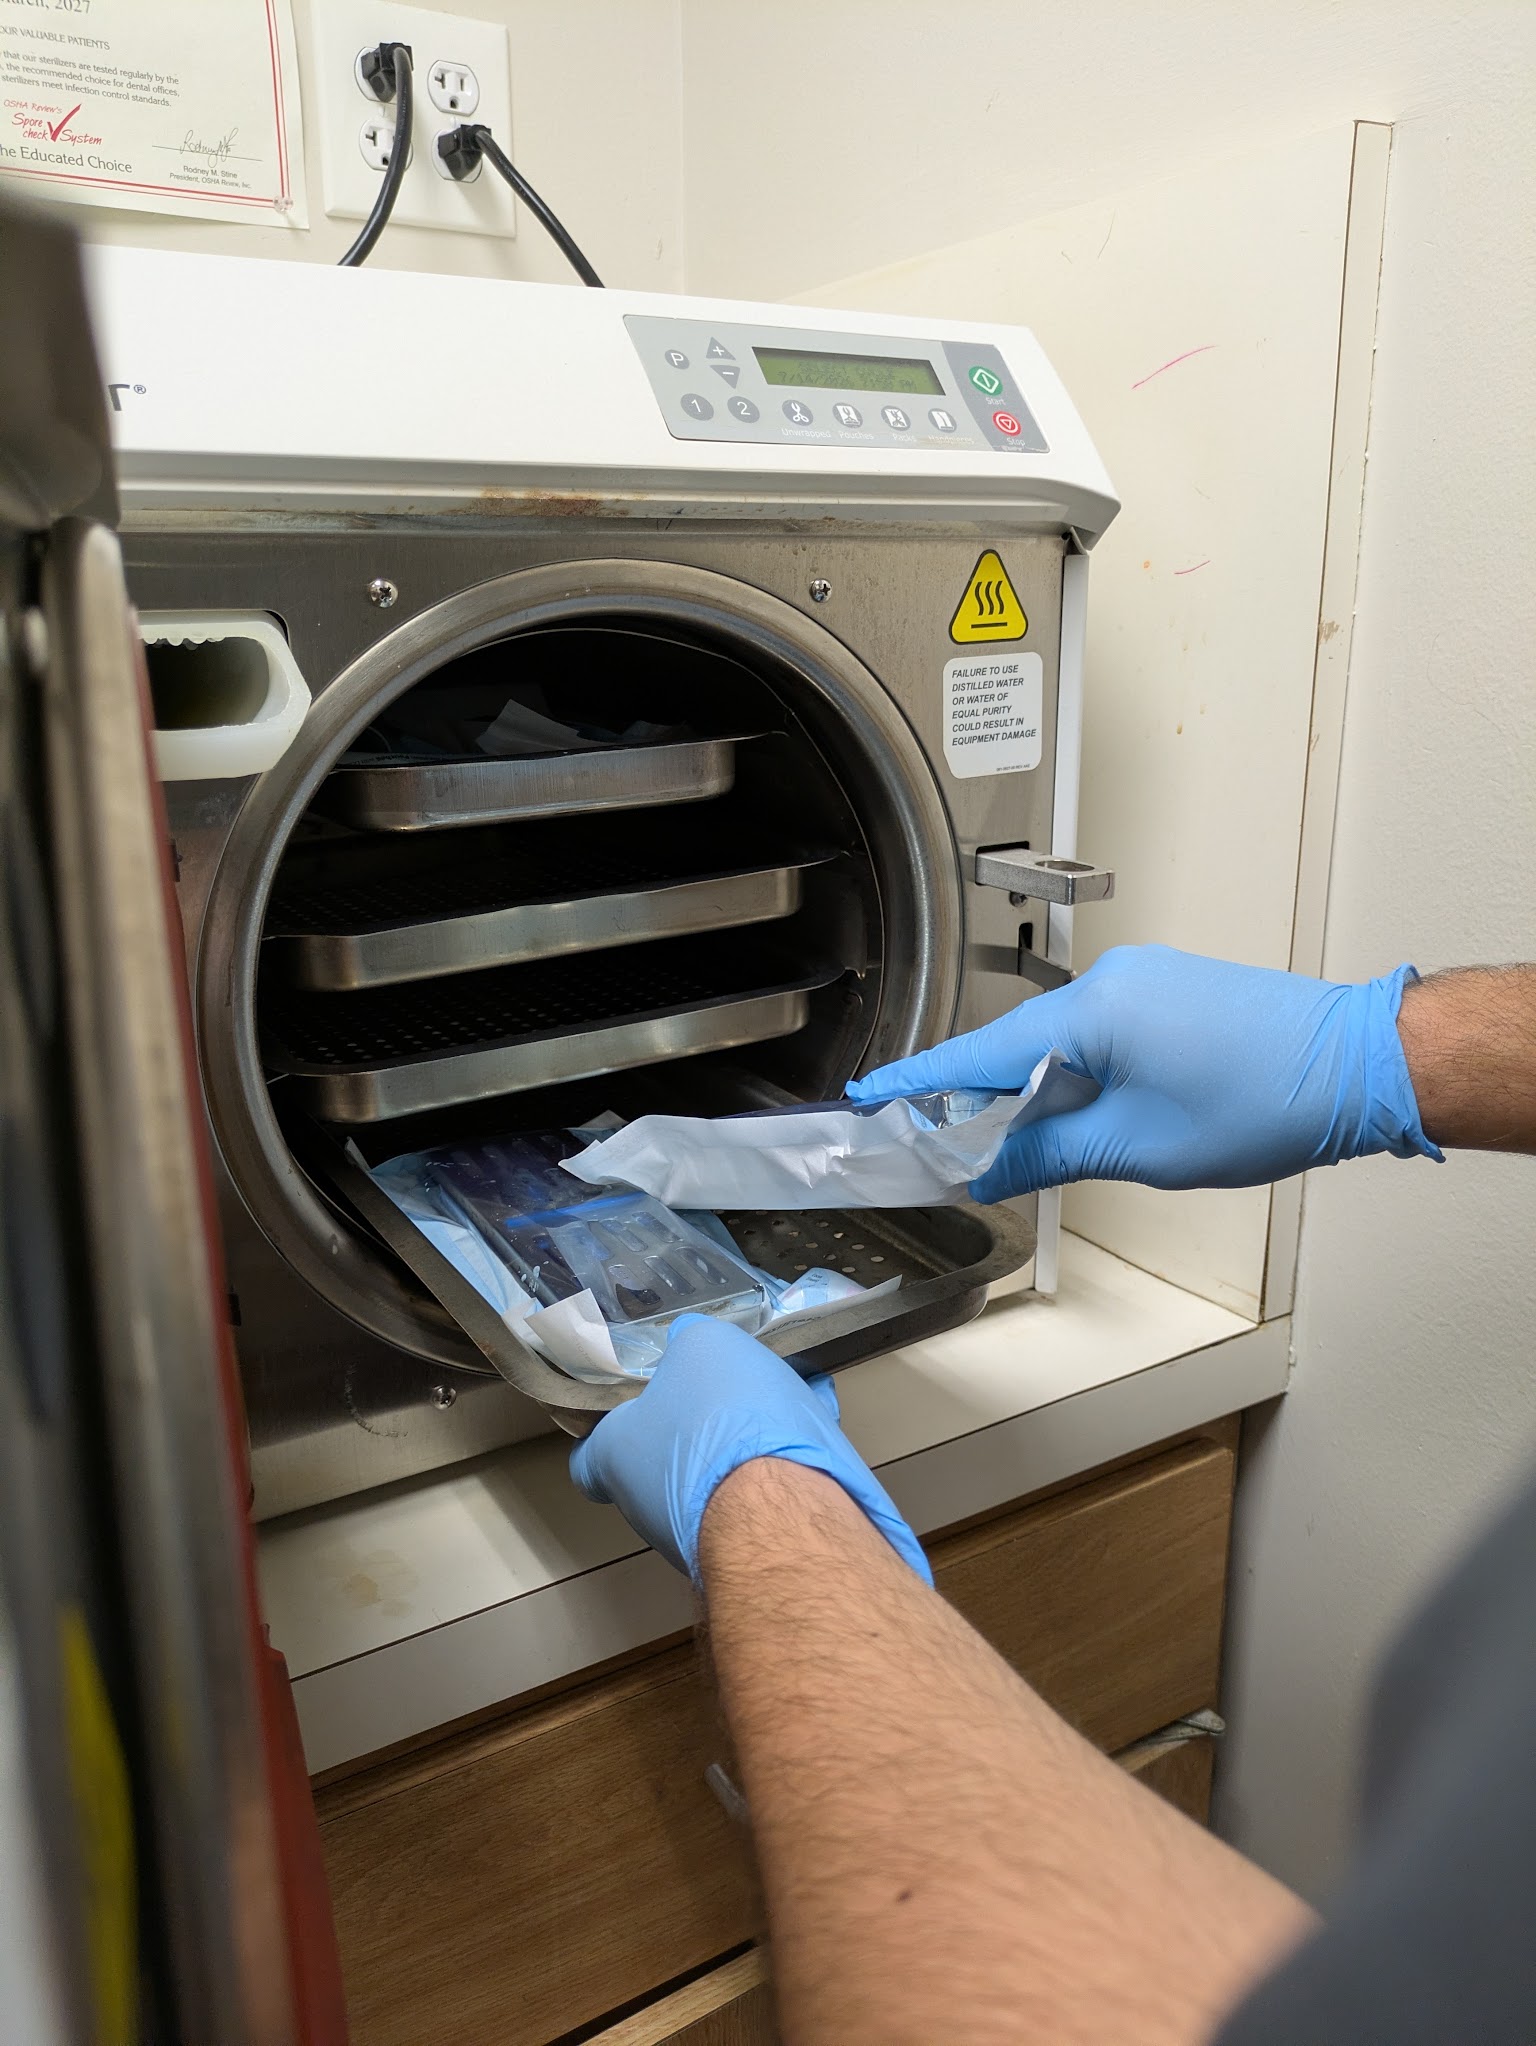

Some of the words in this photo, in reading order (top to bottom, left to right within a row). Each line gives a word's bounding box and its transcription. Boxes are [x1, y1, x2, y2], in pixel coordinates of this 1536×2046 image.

[19, 28, 66, 43] VALUABLE
[67, 35, 110, 50] PATIENTS
[3, 50, 20, 60] that
[22, 54, 37, 62] our
[39, 56, 77, 69] sterilizers
[78, 63, 92, 71] are
[93, 64, 118, 75] tested
[119, 69, 154, 82] regularly
[155, 73, 165, 84] by
[166, 75, 179, 85] the
[6, 62, 20, 72] the
[22, 66, 83, 81] recommended
[85, 75, 111, 86] choice
[113, 78, 124, 88] for
[126, 81, 151, 92] dental
[152, 85, 180, 97] offices,
[1, 75, 40, 87] sterilizers
[42, 81, 63, 91] meet
[65, 83, 100, 96] infection
[101, 90, 130, 101] control
[131, 94, 172, 107] standards.
[3, 99, 28, 110] OSHA
[31, 102, 62, 114] Review's
[11, 112, 43, 129] Spore
[22, 129, 48, 141] check
[60, 128, 102, 147] System
[20, 146, 84, 167] Educated
[87, 155, 133, 173] Choice
[169, 172, 200, 183] President,
[201, 176, 220, 185] OSHA
[183, 165, 210, 177] Rodney
[210, 169, 220, 177] M.
[220, 170, 238, 179] Stine
[670, 352, 684, 366] P
[691, 399, 701, 413] 1
[737, 401, 751, 416] 2
[985, 397, 1006, 406] Start
[781, 427, 832, 439] Unwrapped
[838, 429, 875, 441] Pouches
[1006, 437, 1026, 447] Stop
[952, 667, 987, 679] FAILURE
[989, 666, 1000, 675] TO
[1002, 664, 1019, 674] USE
[952, 680, 994, 692] DISTILLED
[996, 677, 1024, 688] WATER
[952, 696, 965, 706] OR
[966, 693, 995, 704] WATER
[997, 692, 1009, 702] OF
[952, 708, 980, 720] EQUAL
[982, 705, 1012, 716] PURITY
[952, 722, 981, 733] COULD
[983, 718, 1015, 730] RESULT
[1015, 717, 1024, 726] IN
[952, 733, 1001, 746] EQUIPMENT
[1001, 729, 1037, 741] DAMAGE
